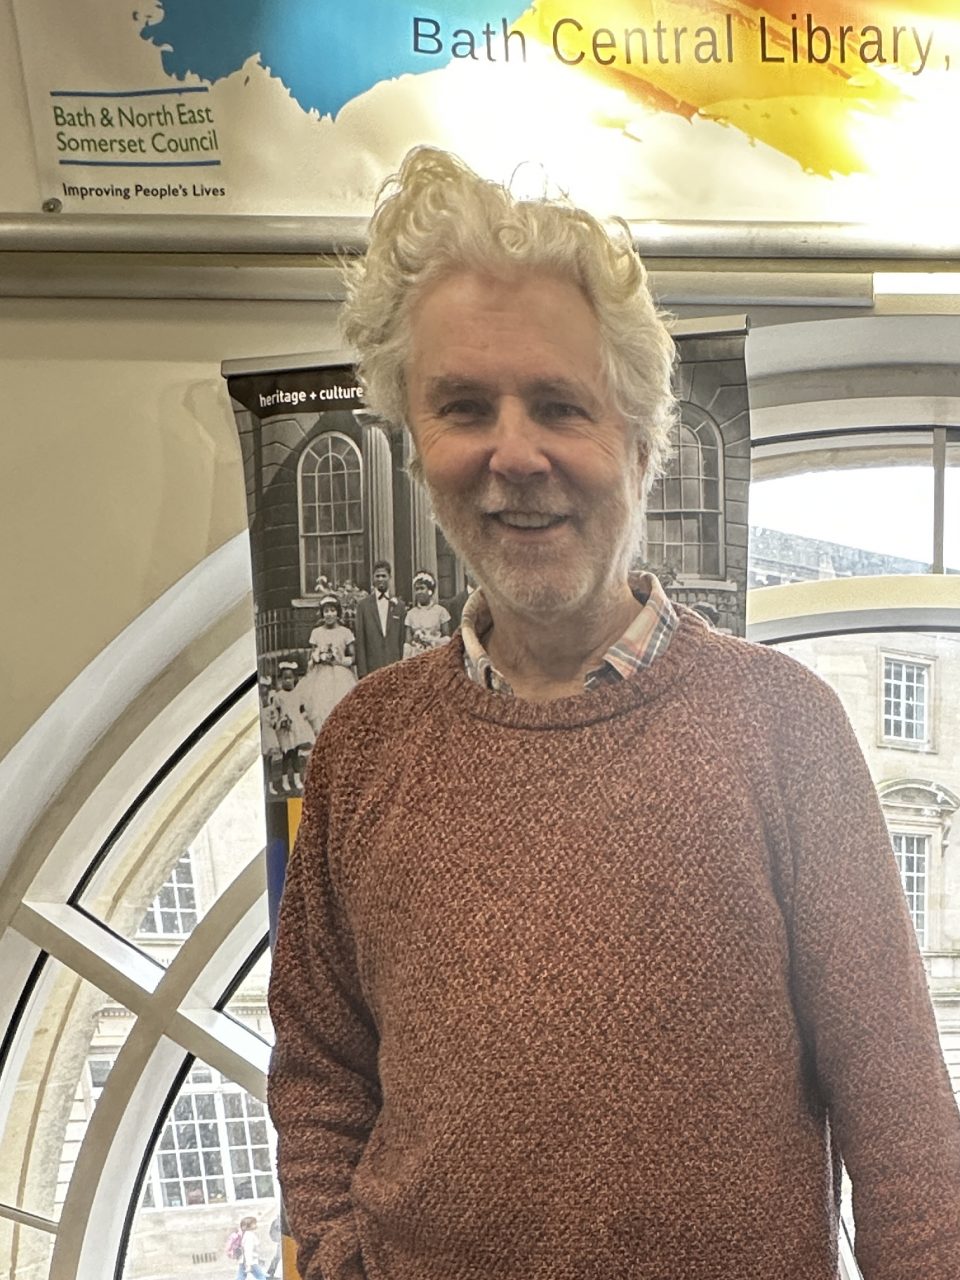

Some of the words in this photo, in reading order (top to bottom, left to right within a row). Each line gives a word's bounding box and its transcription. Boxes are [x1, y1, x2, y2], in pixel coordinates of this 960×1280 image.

[412, 17, 527, 61] Bath
[552, 16, 733, 65] Central
[760, 14, 951, 74] Library,
[53, 106, 95, 127] Bath
[100, 107, 114, 127] &
[118, 105, 173, 127] North
[177, 103, 214, 124] East
[56, 131, 145, 152] Somerset
[152, 130, 218, 152] Council
[63, 183, 130, 199] Improving
[135, 184, 188, 199] People's
[193, 184, 225, 196] Lives
[259, 390, 306, 407] heritage
[320, 385, 364, 400] culture
